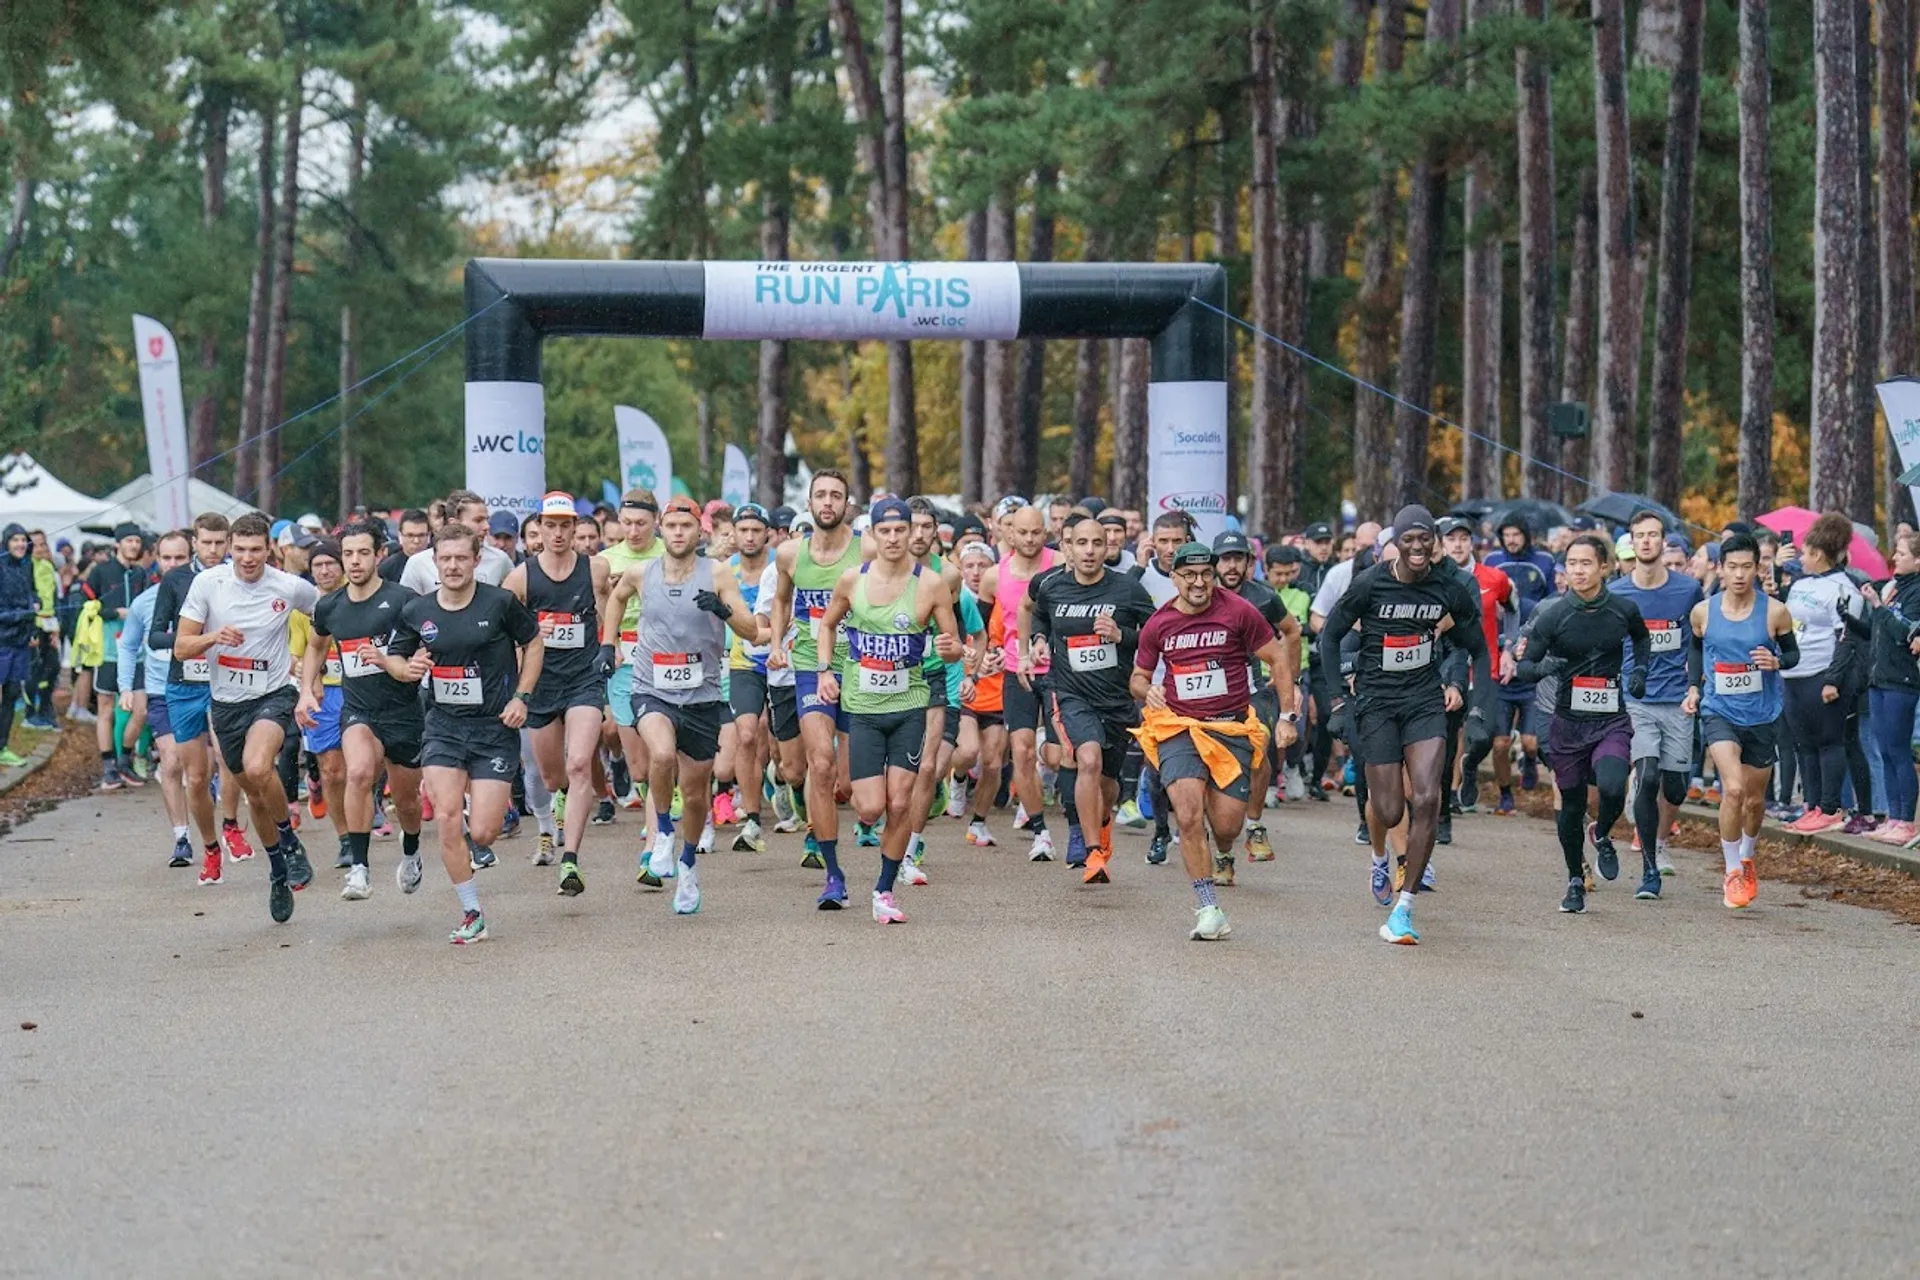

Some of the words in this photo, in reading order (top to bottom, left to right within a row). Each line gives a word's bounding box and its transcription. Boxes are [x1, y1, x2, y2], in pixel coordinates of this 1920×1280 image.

[756, 263, 790, 272] THE
[800, 264, 876, 273] URGENT
[755, 274, 841, 305] RUN
[856, 263, 971, 318] PARIS
[1055, 604, 1067, 617] LE
[1065, 604, 1088, 617] RUN
[1379, 604, 1393, 618] LE
[1392, 604, 1417, 618] RUN
[1416, 604, 1442, 619] CLUB
[858, 632, 910, 656] KEBAB
[1164, 636, 1176, 651] LE
[1175, 633, 1199, 649] RUN
[1200, 631, 1227, 646] CLUB
[1080, 648, 1106, 663] 550
[1395, 649, 1420, 663] 841
[229, 671, 254, 686] 711
[664, 668, 692, 681] 428
[870, 673, 898, 686] 524
[1725, 675, 1751, 688] 320
[443, 682, 470, 695] 725
[1186, 675, 1213, 691] 577
[1583, 691, 1608, 704] 328
